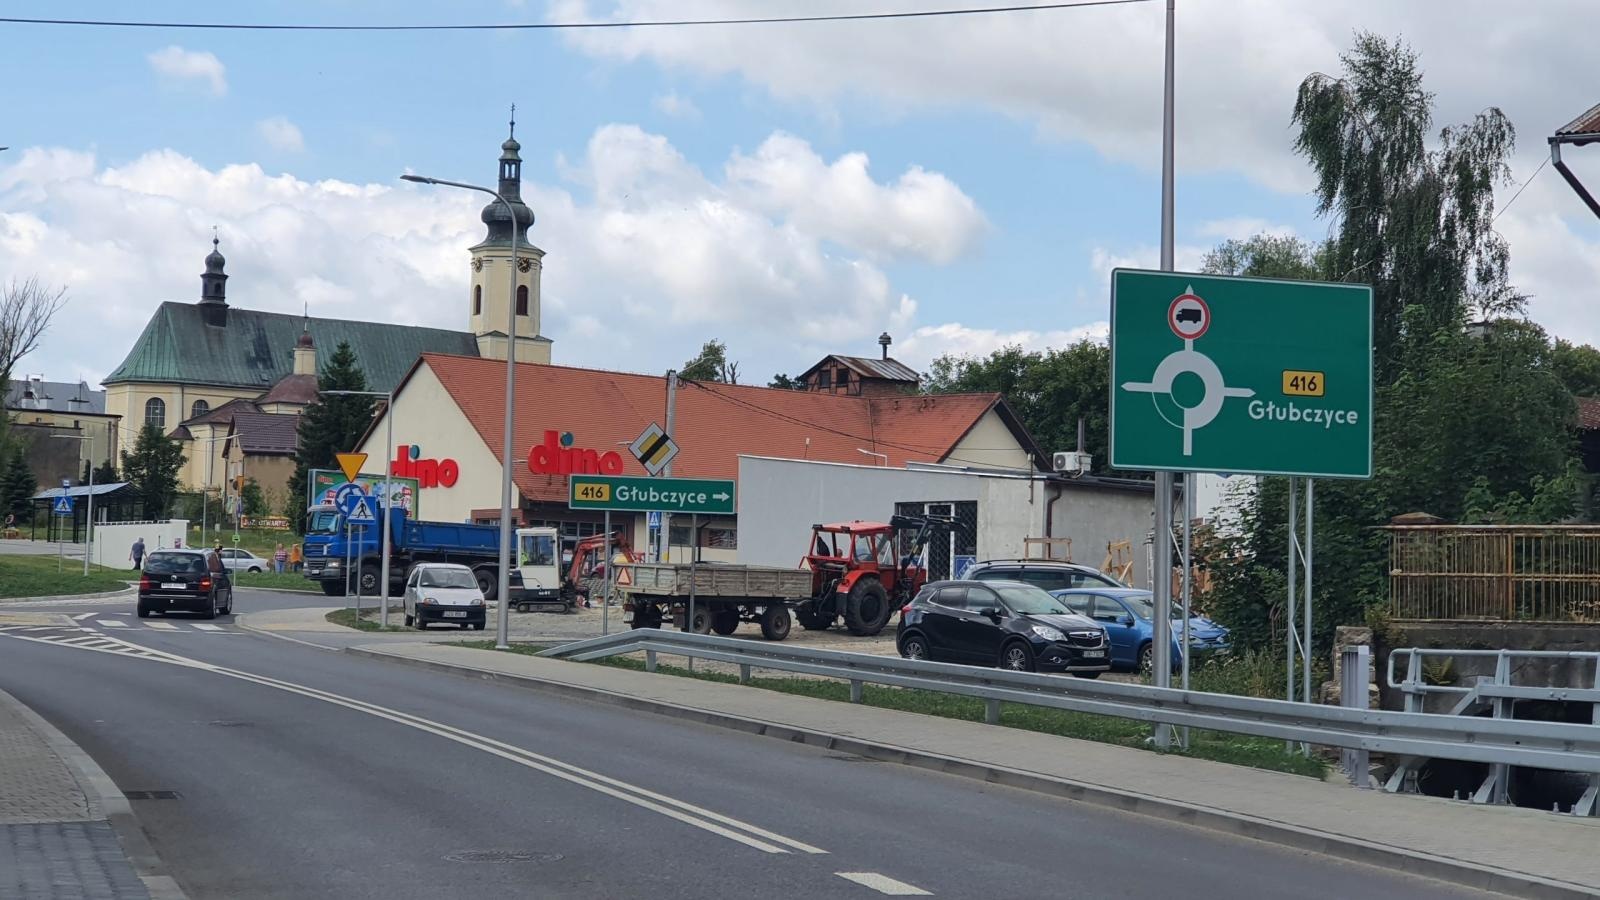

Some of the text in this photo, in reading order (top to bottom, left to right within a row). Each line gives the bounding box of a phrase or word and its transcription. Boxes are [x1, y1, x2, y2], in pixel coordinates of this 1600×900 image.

[1289, 375, 1317, 391] 416
[1248, 399, 1359, 429] Głubczyce
[389, 444, 459, 489] dino
[528, 430, 624, 475] dino
[581, 485, 707, 507] 416 Głubczyce
